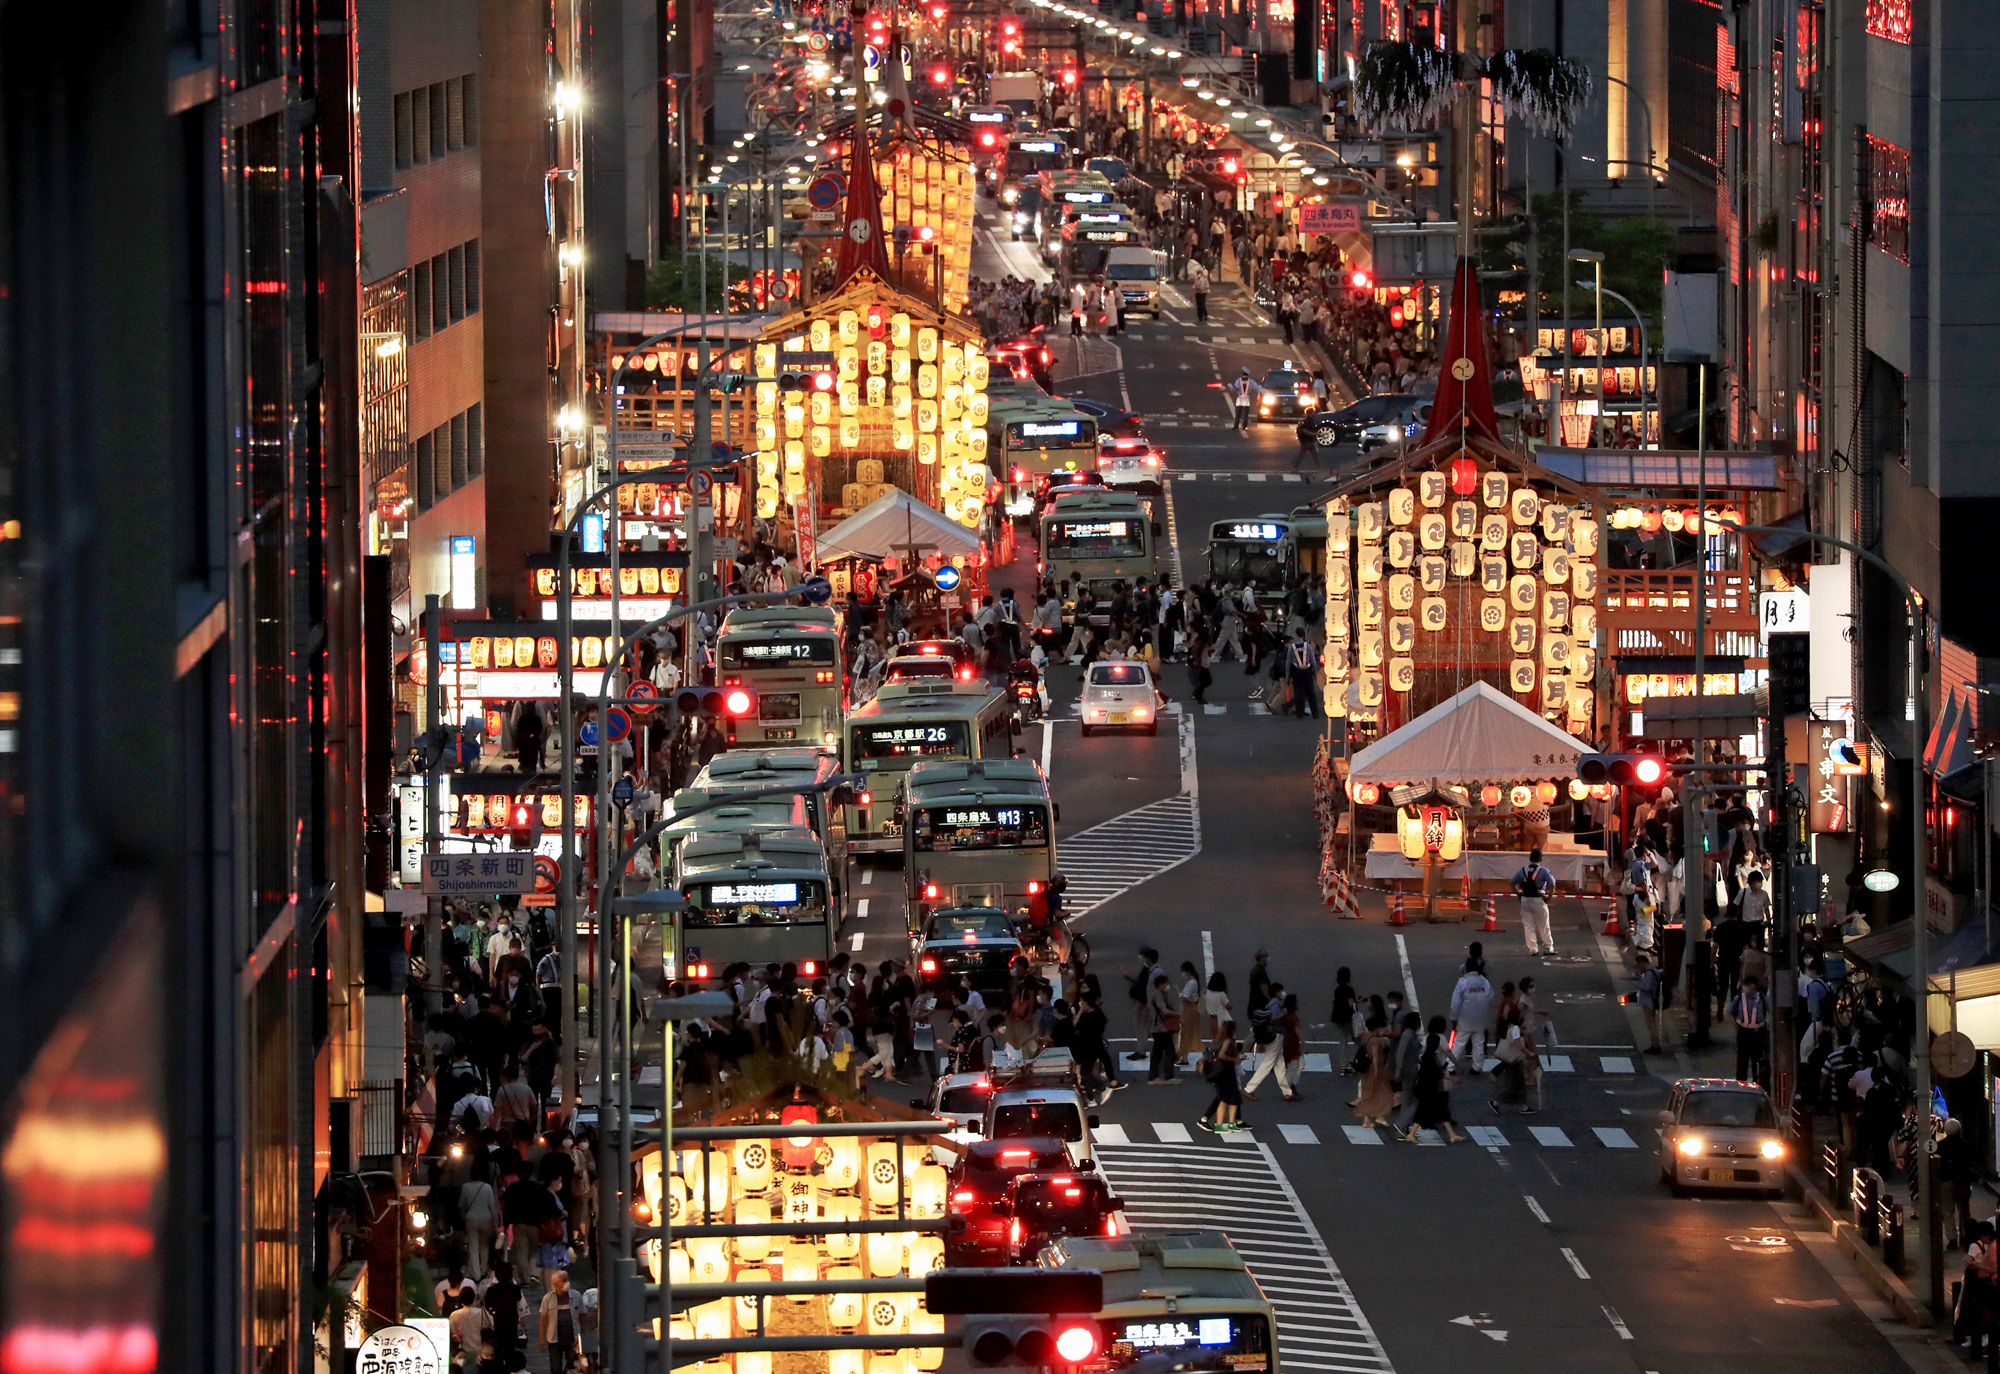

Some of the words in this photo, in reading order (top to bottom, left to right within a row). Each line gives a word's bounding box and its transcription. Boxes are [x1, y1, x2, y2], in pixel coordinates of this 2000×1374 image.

[1305, 209, 1355, 220] 四条烏丸
[575, 606, 660, 617] ホリーカフェ
[540, 639, 554, 665] 月鉾
[794, 645, 810, 658] 12
[893, 729, 926, 739] 京都駅
[927, 728, 947, 742] 26
[492, 795, 506, 826] 月鉾
[946, 811, 991, 823] 四条烏丸
[998, 810, 1020, 825] 特13
[1425, 811, 1444, 849] 月鉾
[431, 858, 525, 877] 四条新町
[439, 879, 518, 891] Shijoshinmachi
[1868, 875, 1896, 883] 処方せん
[791, 1181, 809, 1223] 御神
